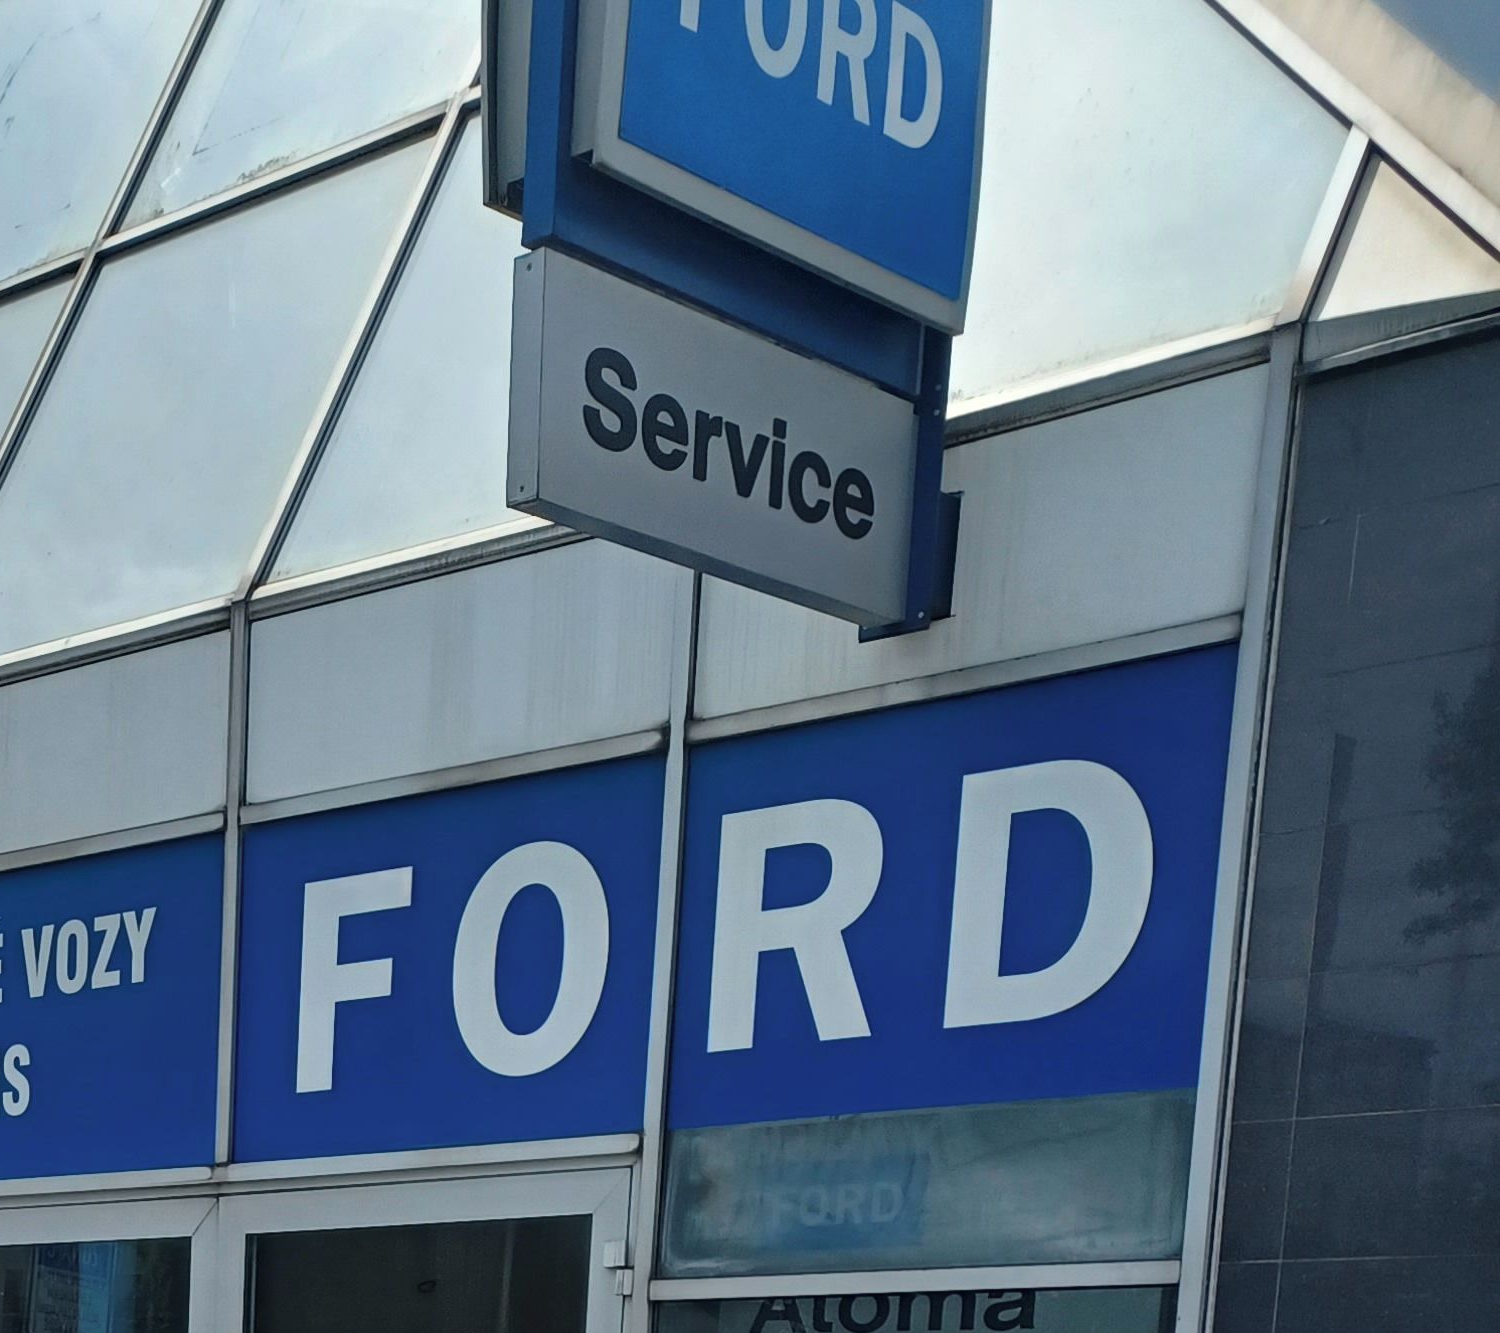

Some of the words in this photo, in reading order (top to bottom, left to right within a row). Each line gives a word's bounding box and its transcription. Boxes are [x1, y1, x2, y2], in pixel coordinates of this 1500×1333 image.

[680, 0, 943, 149] ORD
[583, 347, 875, 540] Service
[21, 907, 157, 999] VOZY
[296, 759, 1154, 1094] FORD
